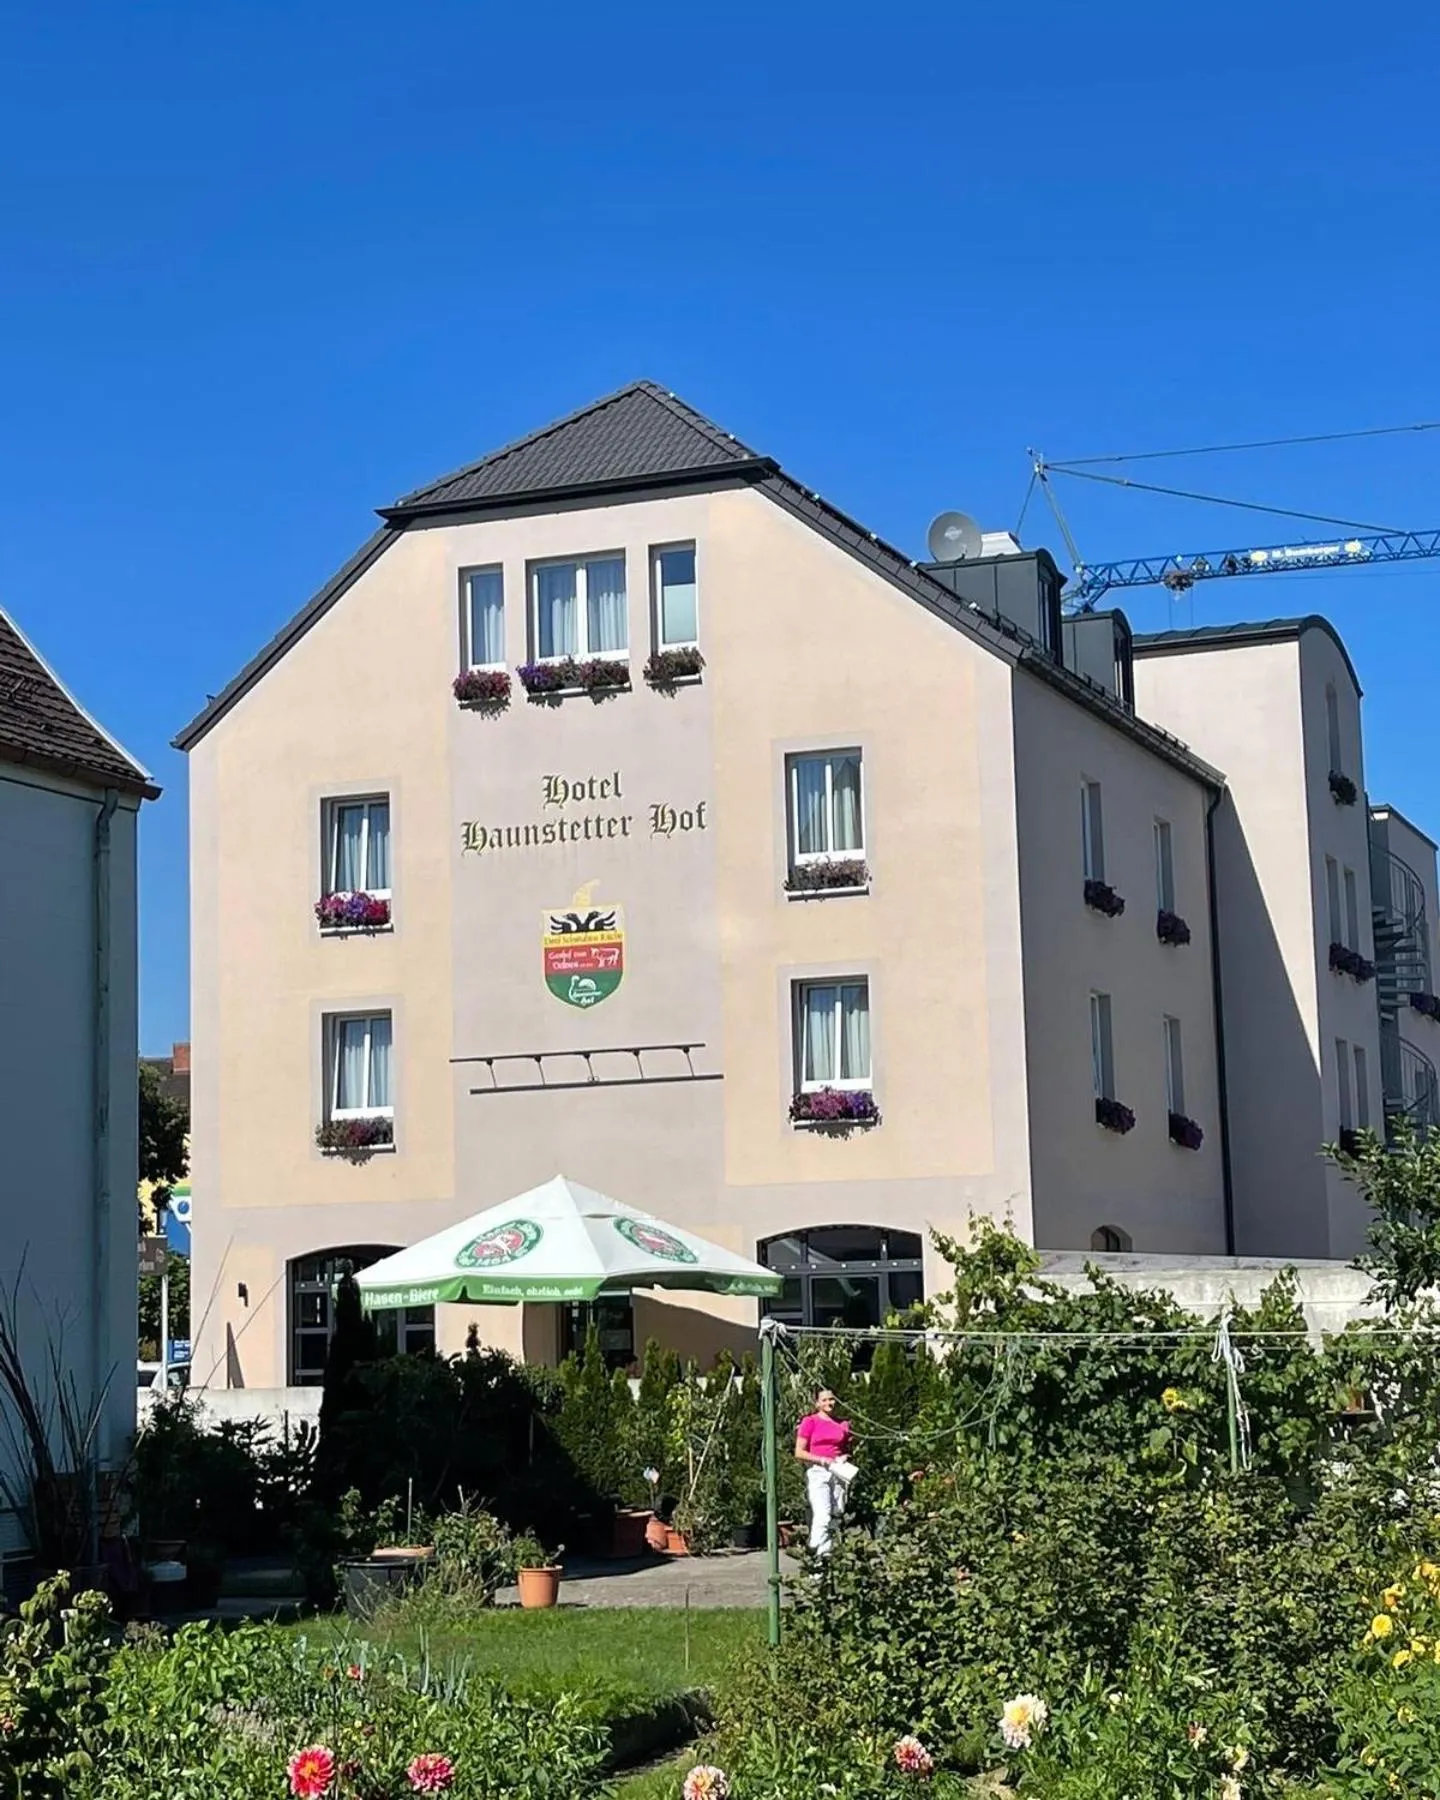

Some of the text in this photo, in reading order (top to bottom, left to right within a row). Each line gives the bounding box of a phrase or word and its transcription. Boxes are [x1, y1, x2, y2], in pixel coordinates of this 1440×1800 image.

[542, 770, 623, 810] Hotel
[461, 801, 707, 857] Haunstetter Hof
